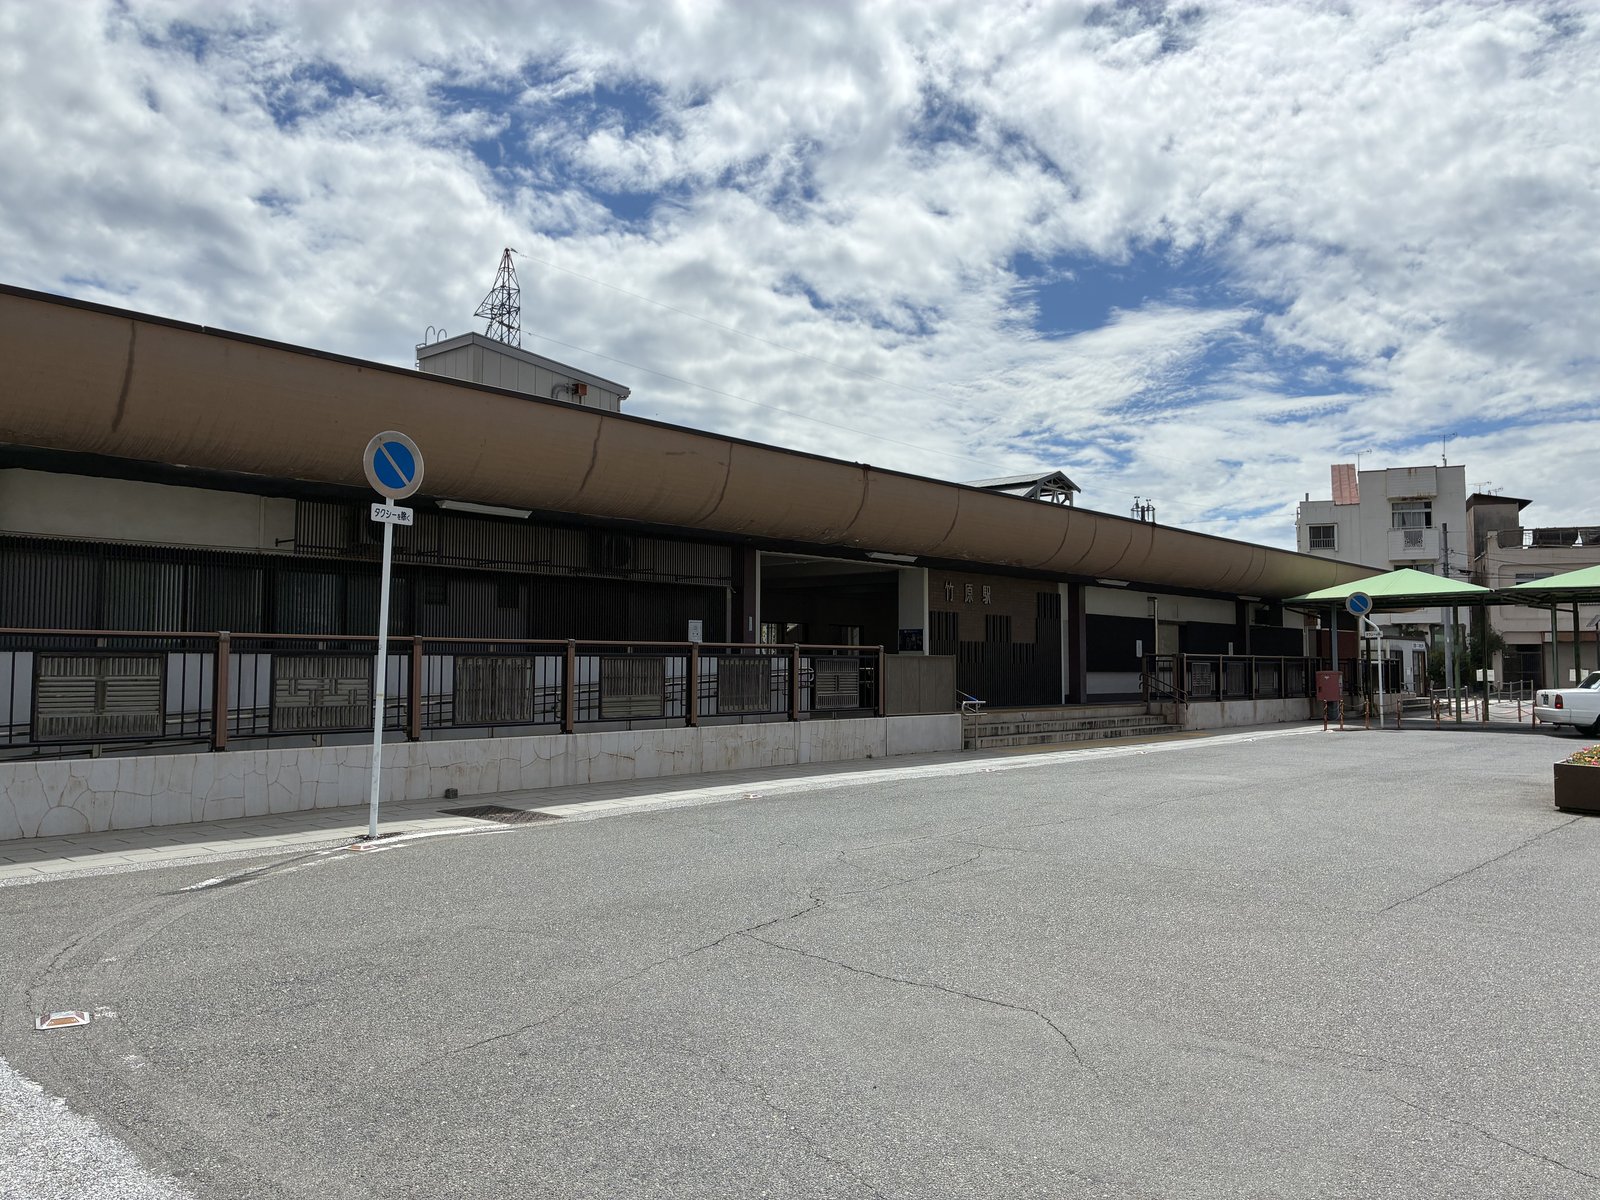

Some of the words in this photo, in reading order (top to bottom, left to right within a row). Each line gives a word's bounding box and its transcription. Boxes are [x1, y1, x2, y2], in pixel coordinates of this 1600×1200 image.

[374, 507, 410, 522] タクシーを除く
[944, 580, 991, 605] 竹原駅
